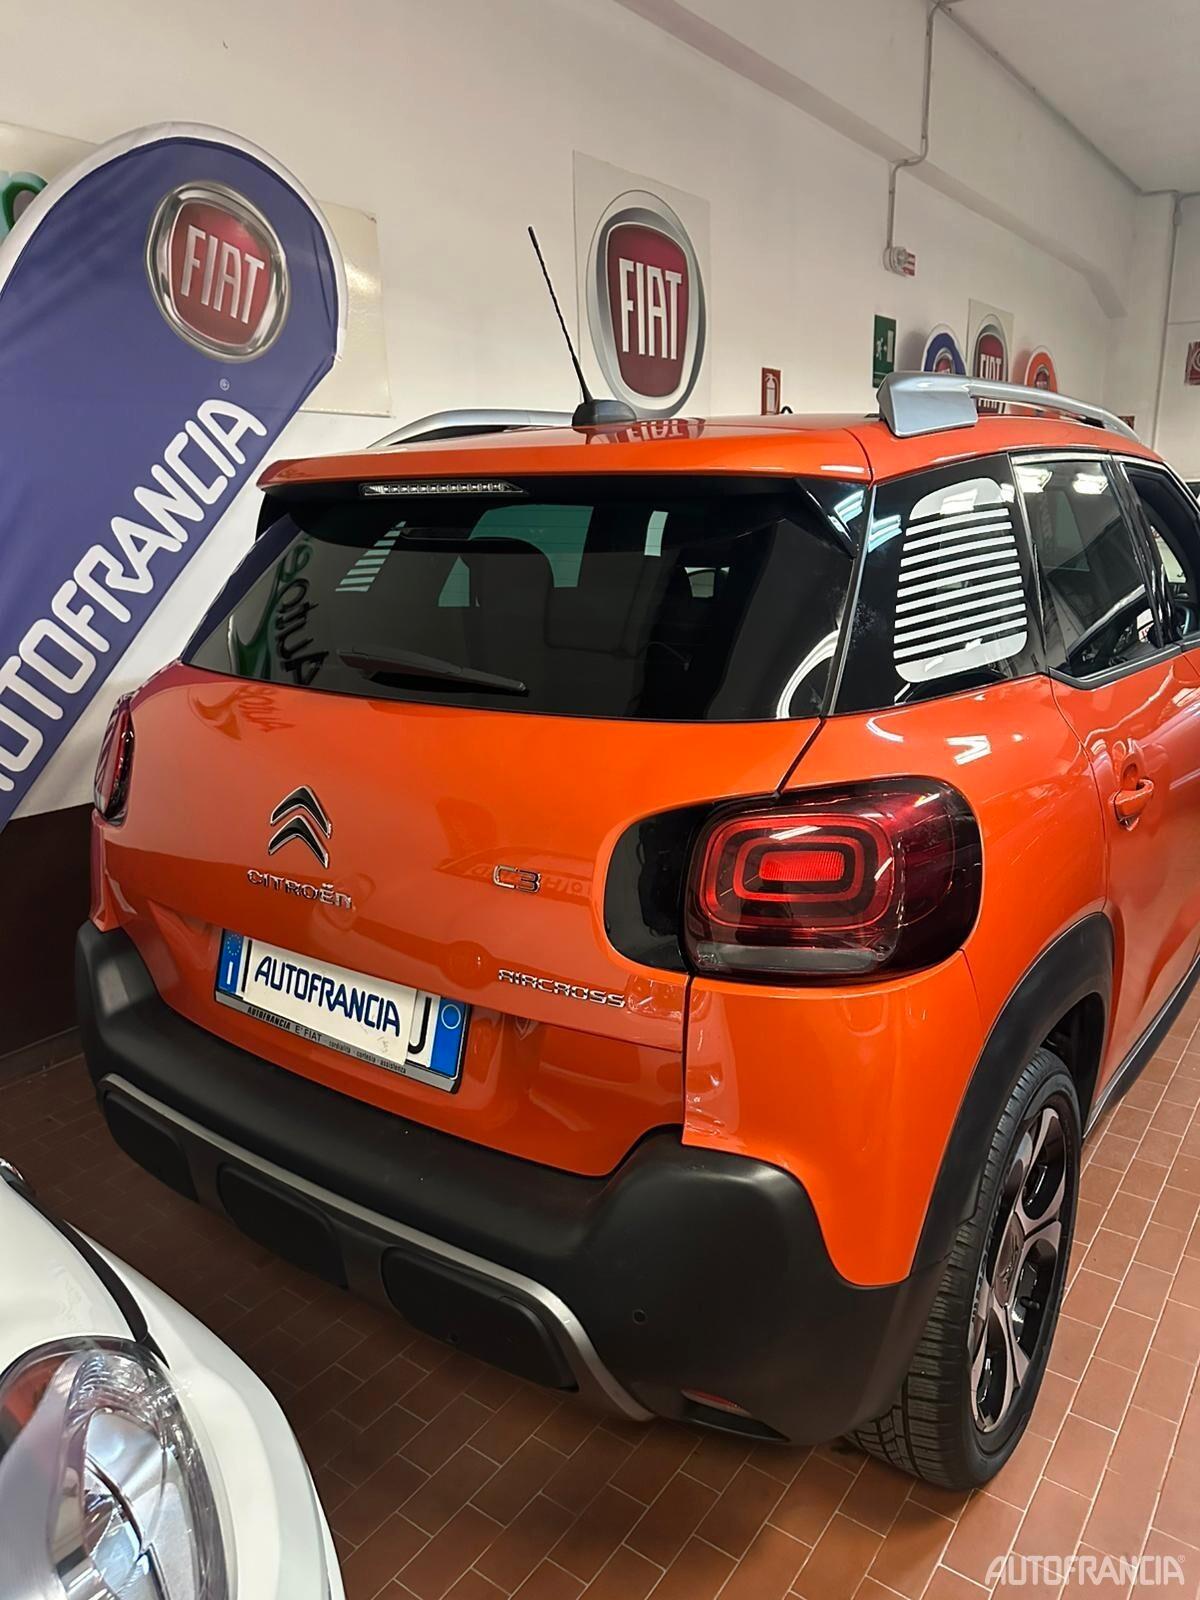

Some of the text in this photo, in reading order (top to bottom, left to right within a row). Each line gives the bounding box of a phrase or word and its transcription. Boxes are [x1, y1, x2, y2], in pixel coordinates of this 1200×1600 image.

[180, 224, 265, 325] FIAT
[618, 257, 682, 361] FIAT
[492, 864, 541, 893] C3
[254, 955, 400, 1037] AUTOFRANCIA
[498, 968, 626, 1009] AIRCROSS
[247, 1006, 291, 1031] AUTOFRANCIA
[304, 1028, 322, 1043] FIAT
